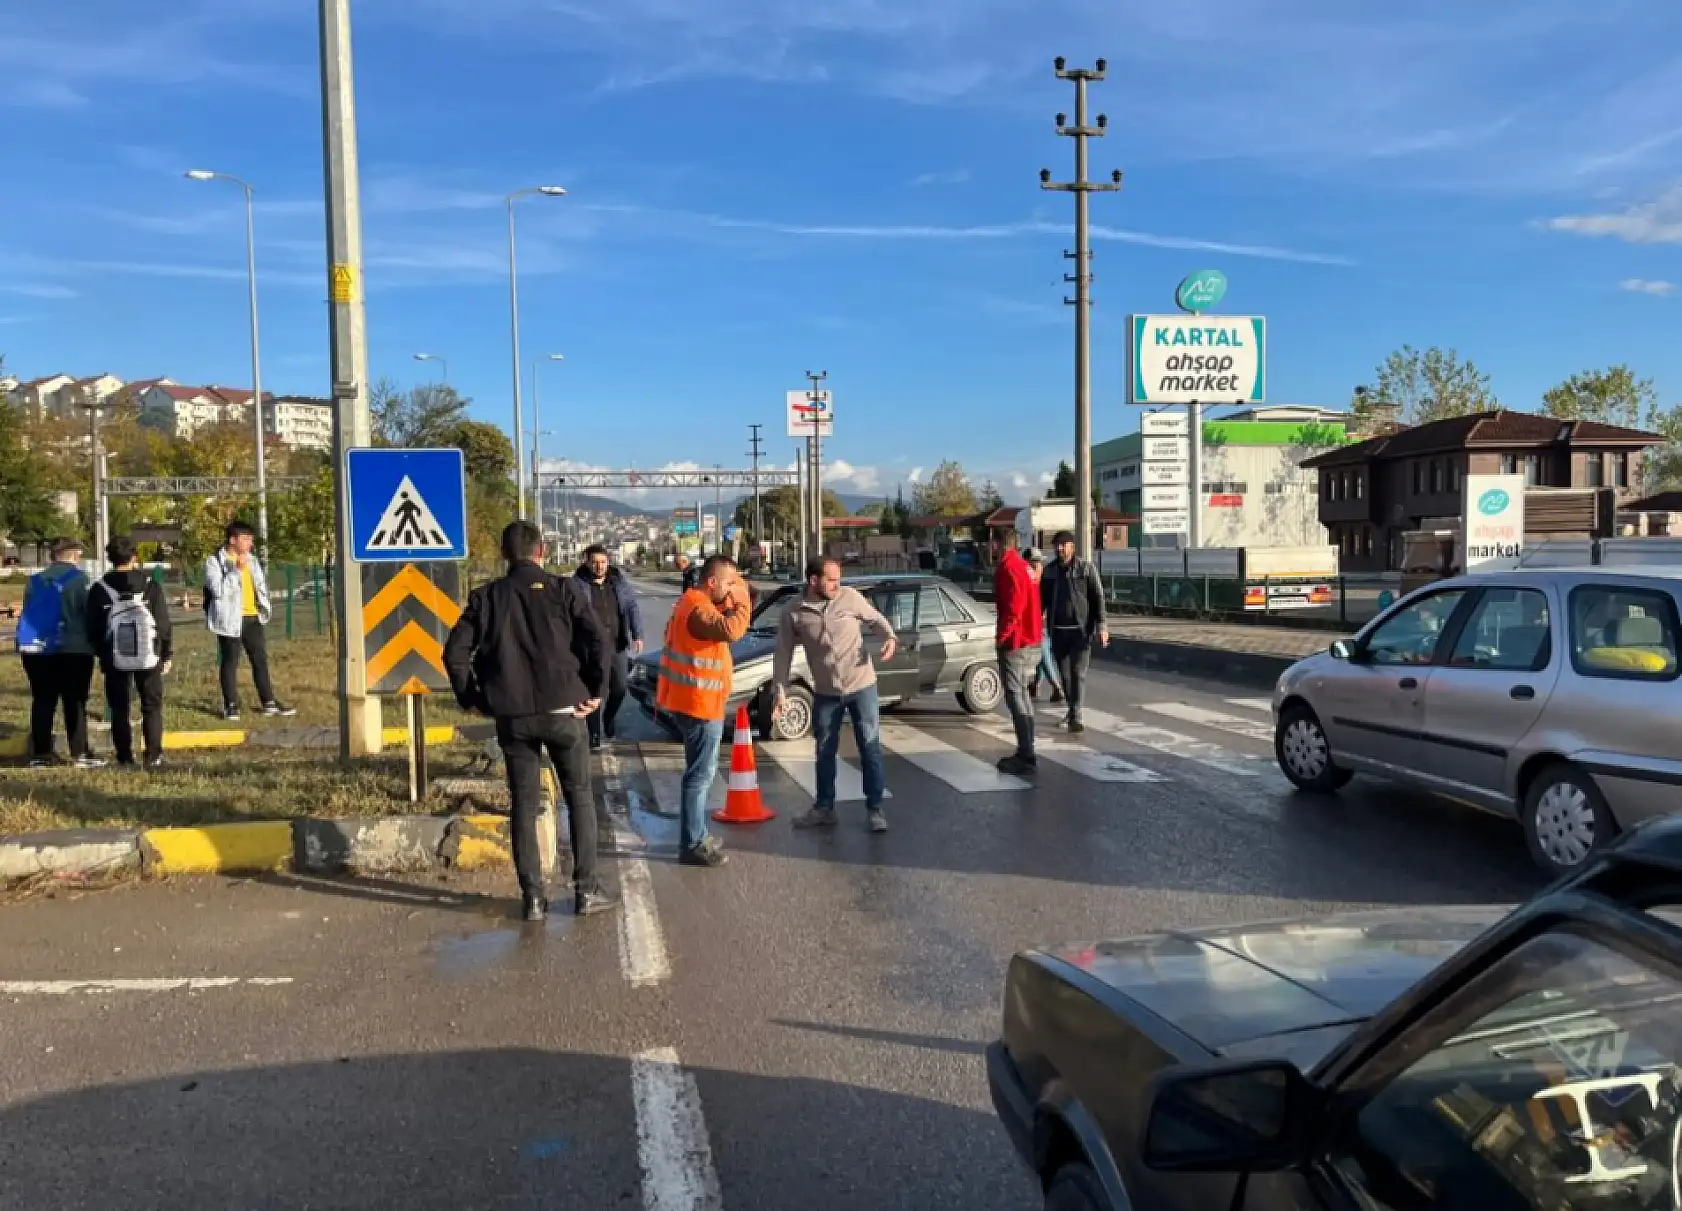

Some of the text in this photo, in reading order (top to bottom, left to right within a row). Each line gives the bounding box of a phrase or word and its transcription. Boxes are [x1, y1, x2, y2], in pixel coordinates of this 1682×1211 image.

[1155, 327, 1243, 347] KARTAL
[1165, 353, 1233, 374] ahşap
[1159, 374, 1239, 391] market
[1468, 542, 1520, 558] market
